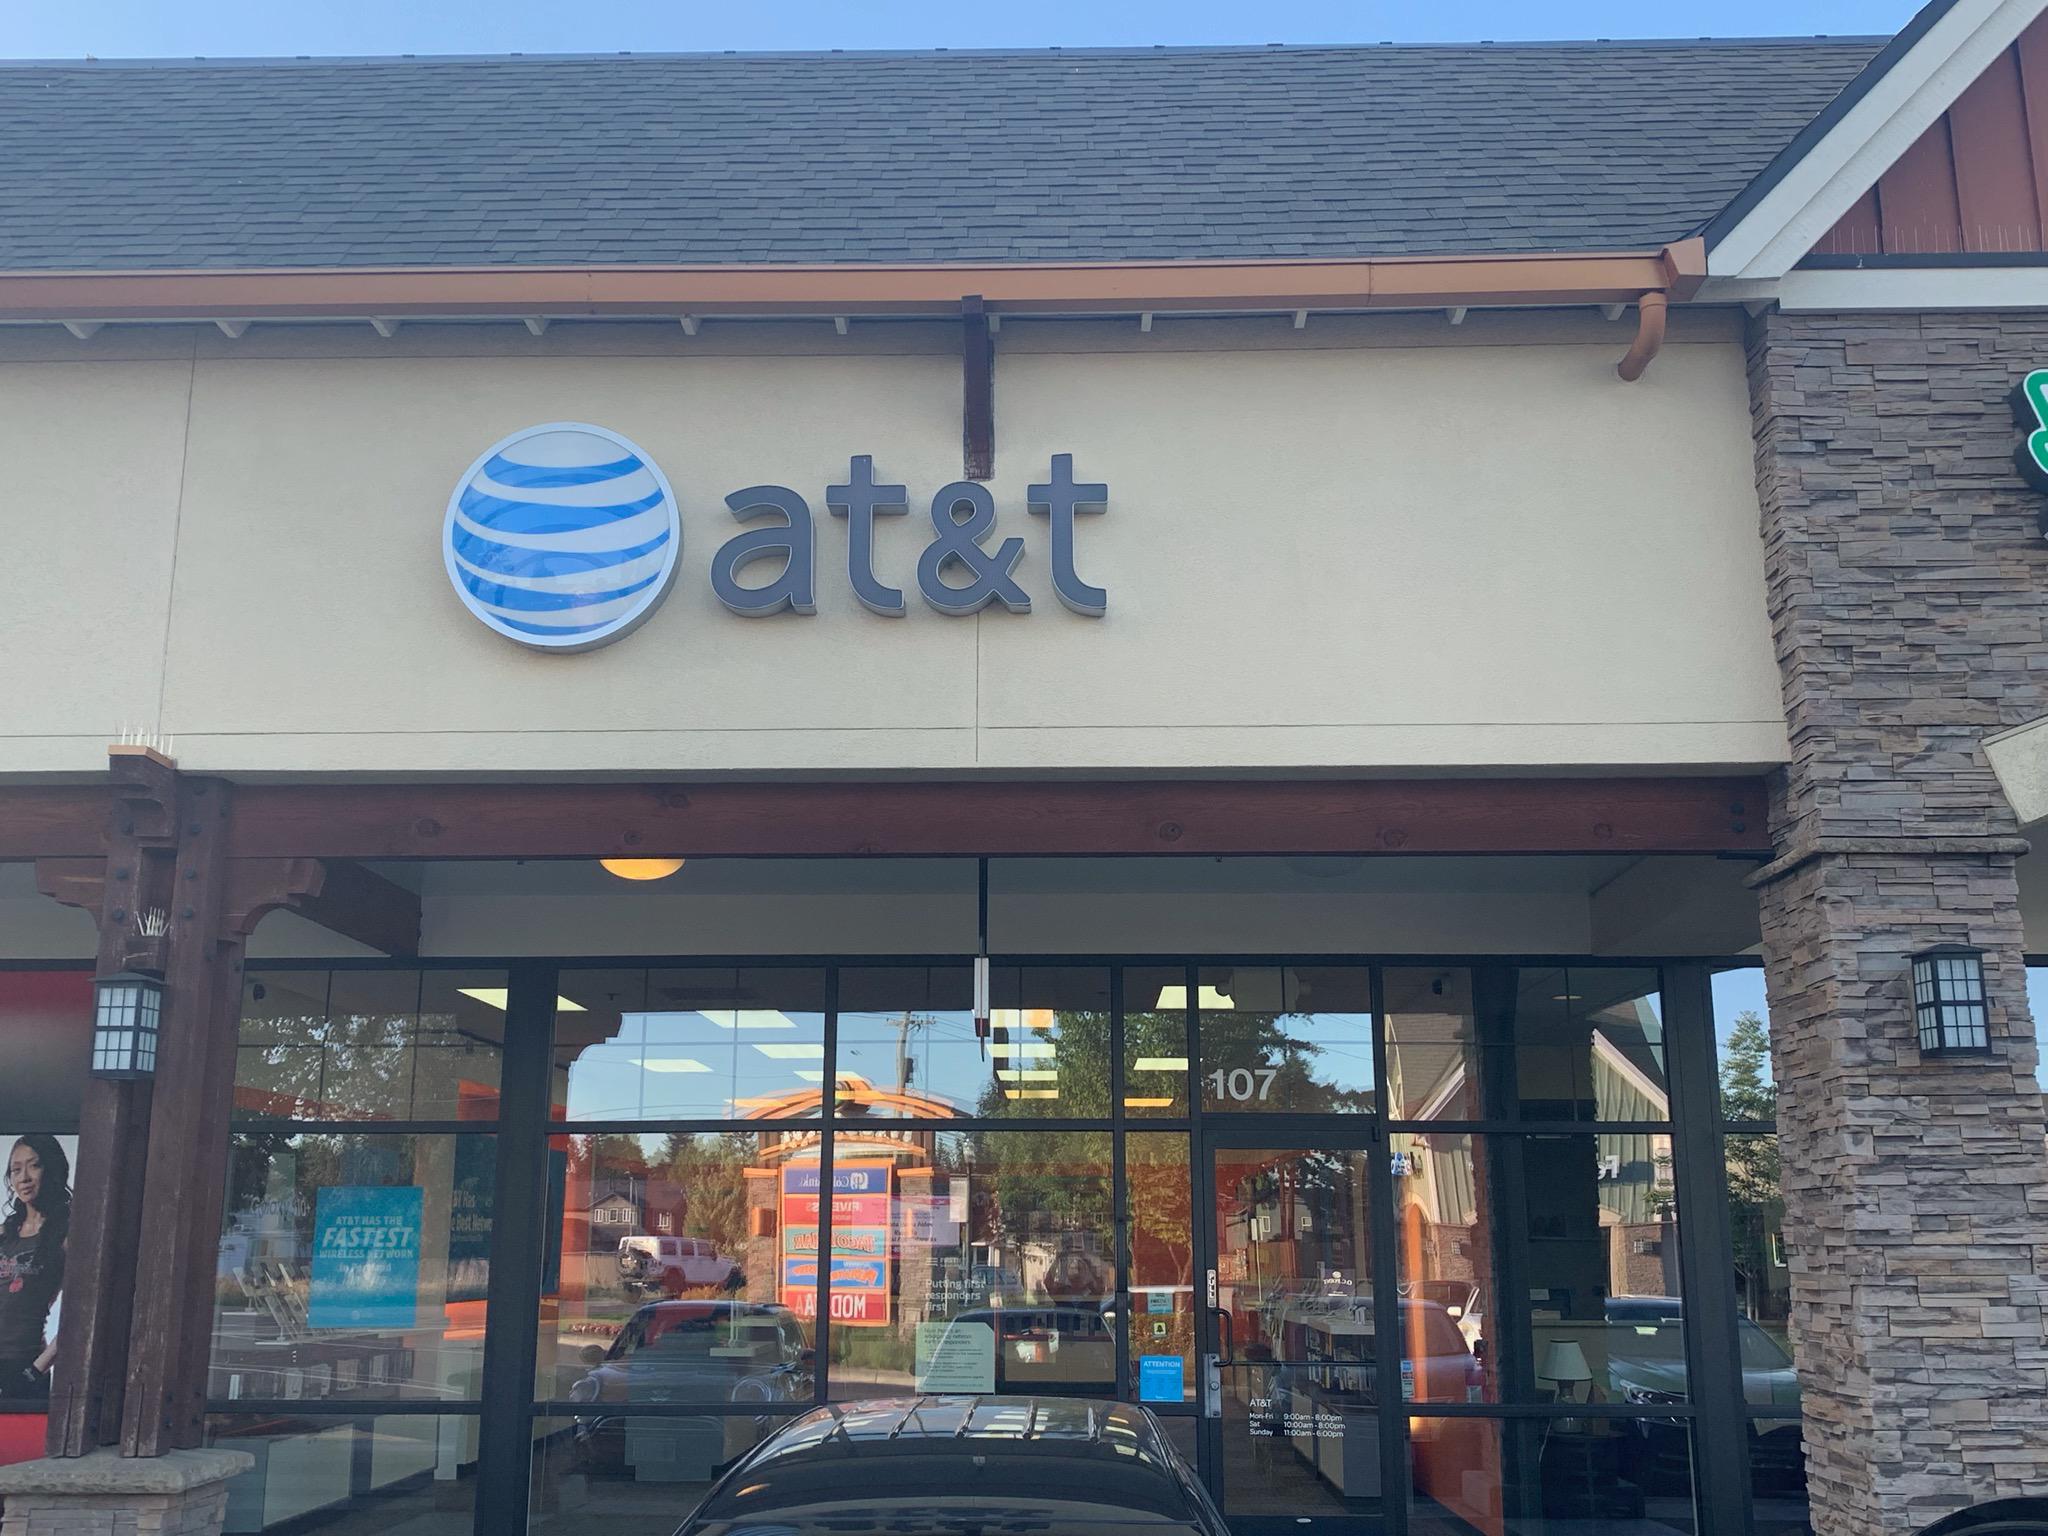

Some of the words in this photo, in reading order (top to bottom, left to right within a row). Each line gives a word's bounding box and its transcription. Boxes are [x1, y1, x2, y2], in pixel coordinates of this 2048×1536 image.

[710, 453, 1110, 618] at&t
[1208, 1068, 1277, 1101] 107
[362, 1215, 381, 1225] HAS
[384, 1215, 403, 1225] THE
[322, 1226, 414, 1248] FASTEST
[320, 1248, 365, 1259] WIRELESS
[926, 1280, 961, 1290] Putting
[964, 1279, 985, 1288] first
[926, 1290, 981, 1301] responders
[926, 1301, 946, 1312] first
[1143, 1360, 1181, 1368] ATTENTION
[1249, 1398, 1273, 1408] AT&T
[1249, 1412, 1274, 1420] Mon-Fri
[1284, 1421, 1313, 1429] 10:00am
[1318, 1422, 1346, 1430] 8:00pm
[1249, 1429, 1274, 1437] Sunday
[1284, 1429, 1312, 1437] 11:00am
